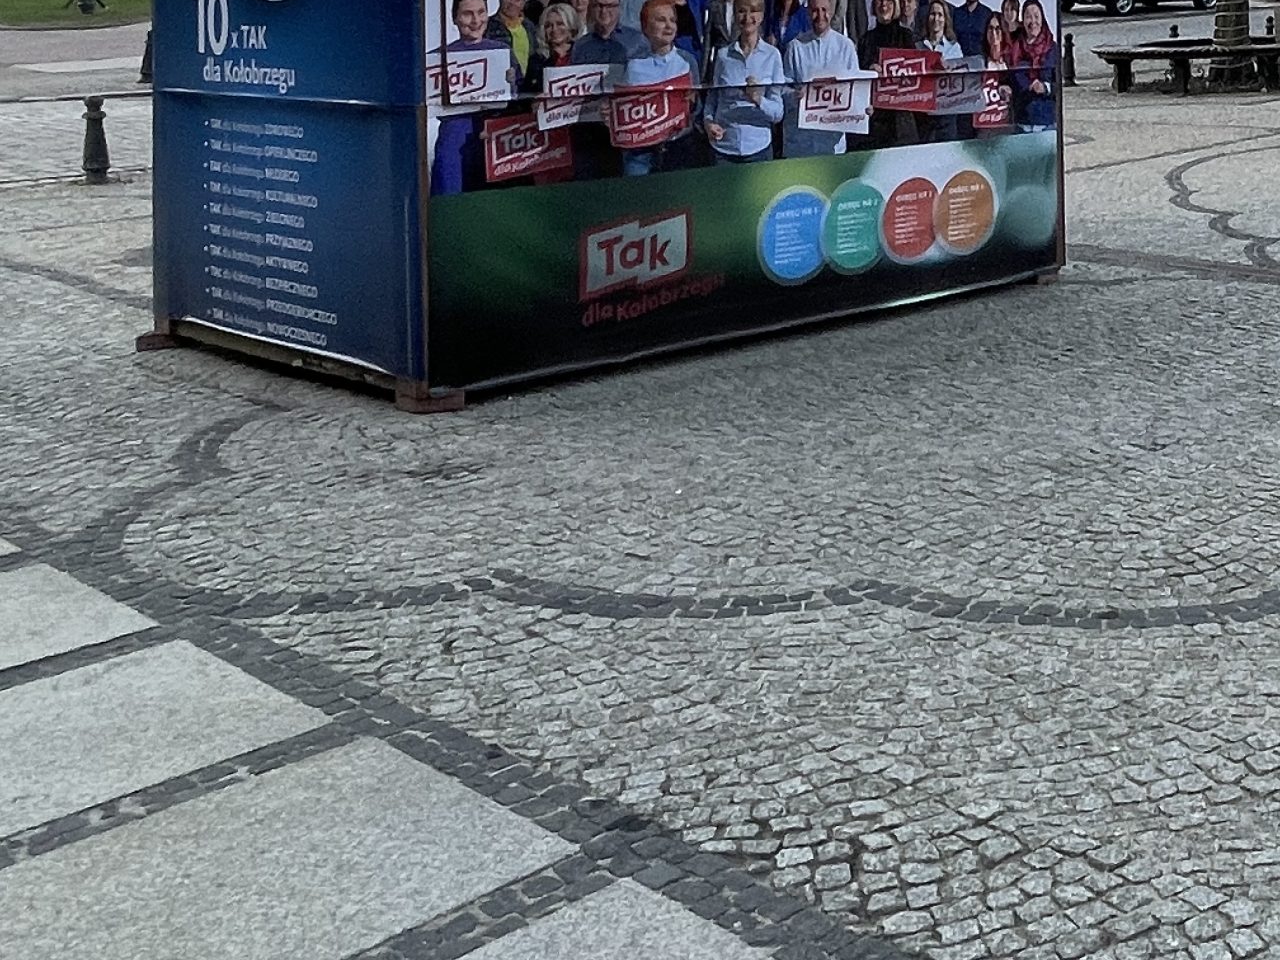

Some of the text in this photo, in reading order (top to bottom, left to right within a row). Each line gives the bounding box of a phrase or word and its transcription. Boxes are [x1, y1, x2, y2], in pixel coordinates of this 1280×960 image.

[240, 25, 267, 50] TAK
[203, 56, 295, 94] dla Kołobrzegu
[813, 85, 843, 106] Tak
[619, 102, 658, 122] Tak
[500, 130, 539, 153] Tak
[597, 234, 671, 276] Tak
